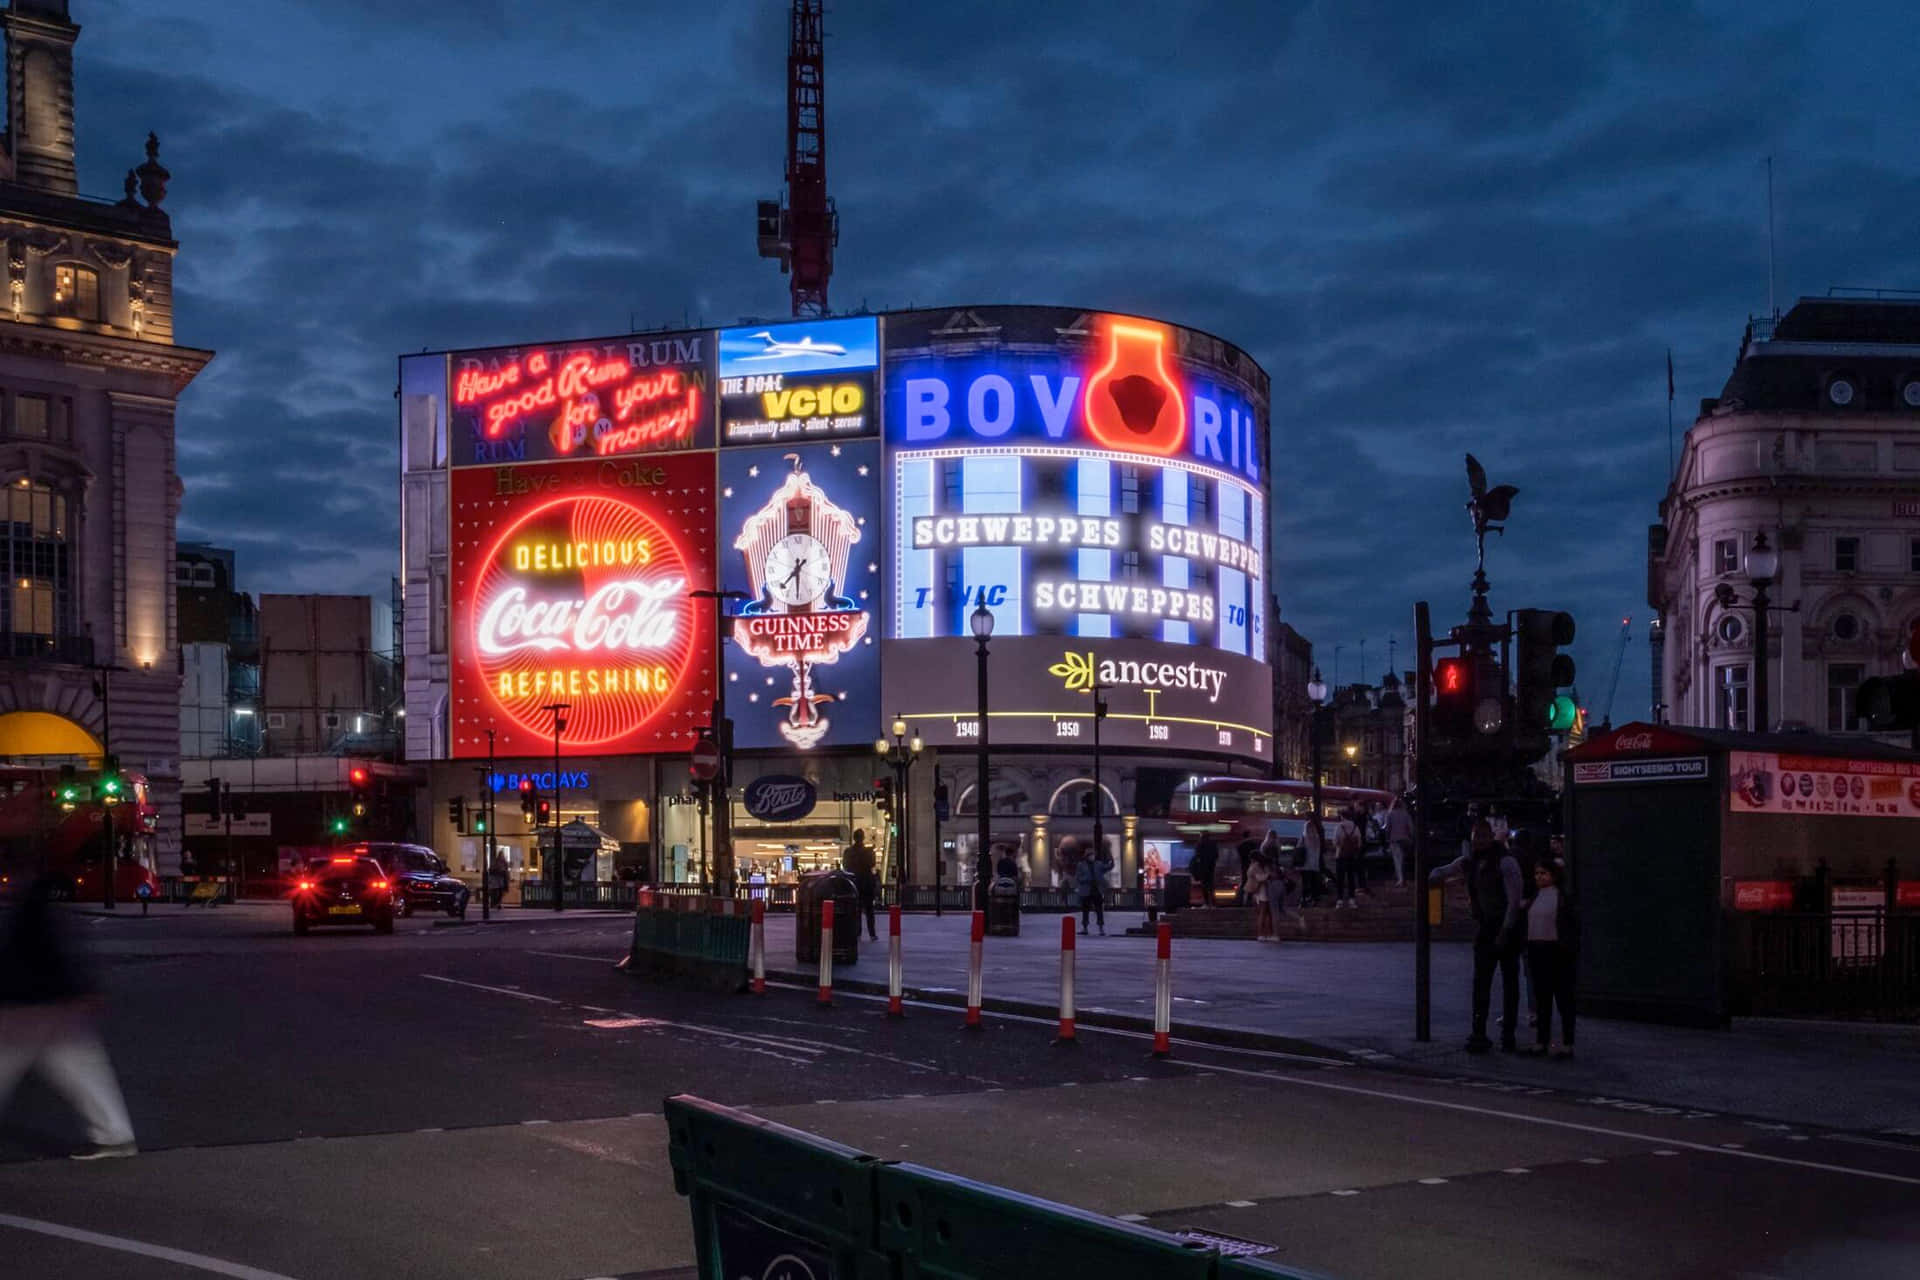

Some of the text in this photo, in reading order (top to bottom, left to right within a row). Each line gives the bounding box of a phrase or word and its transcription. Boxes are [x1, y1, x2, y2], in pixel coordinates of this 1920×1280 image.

[627, 337, 702, 367] RUM
[457, 364, 519, 402] Have
[529, 353, 547, 374] a
[721, 378, 743, 394] THE
[489, 378, 556, 435] good
[558, 356, 628, 397] Rum
[764, 384, 863, 418] VC10
[560, 399, 600, 451] for
[616, 373, 678, 420] your
[600, 389, 697, 454] money!
[780, 418, 800, 432] swift
[806, 417, 828, 430] silent
[835, 416, 863, 429] serene
[598, 461, 668, 488] Coke
[915, 516, 1121, 546] SCHWEPPES
[516, 540, 651, 570] DELICIOUS
[478, 578, 685, 654] Coca-Cola
[1035, 582, 1214, 621] SCHWEPPES
[750, 615, 849, 635] GUINNESS
[774, 632, 825, 651] TIME
[499, 666, 668, 698] REFRESHING
[1099, 658, 1226, 703] ancestry
[1057, 722, 1080, 737] 1950
[1677, 760, 1703, 775] TOUR
